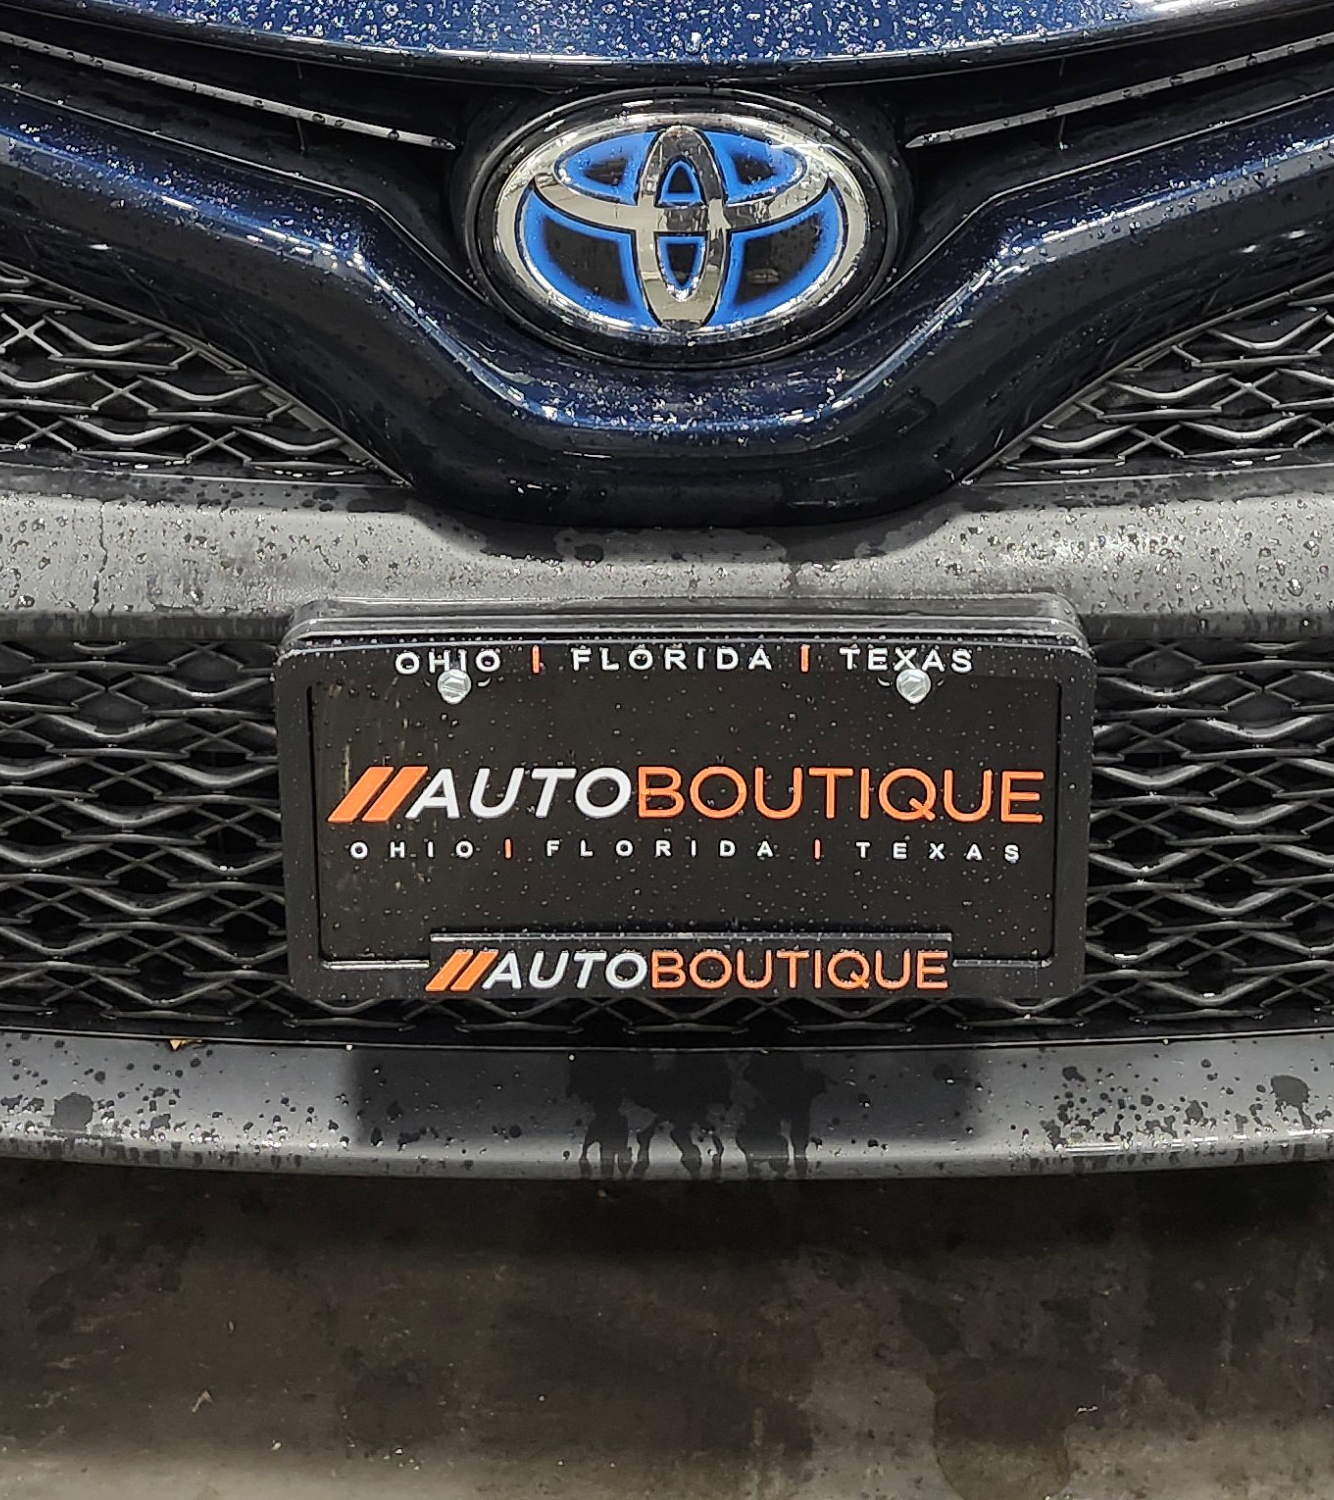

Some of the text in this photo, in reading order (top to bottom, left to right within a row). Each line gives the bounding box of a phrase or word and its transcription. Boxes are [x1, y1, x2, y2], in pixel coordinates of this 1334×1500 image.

[394, 645, 973, 675] OHIO FLORIDA TEXAS
[405, 765, 1045, 824] AUTOBOUTIQUE
[349, 839, 1021, 863] OHIO FLORIDA TEXAS
[480, 948, 949, 990] AUTOBOUTIQUE
